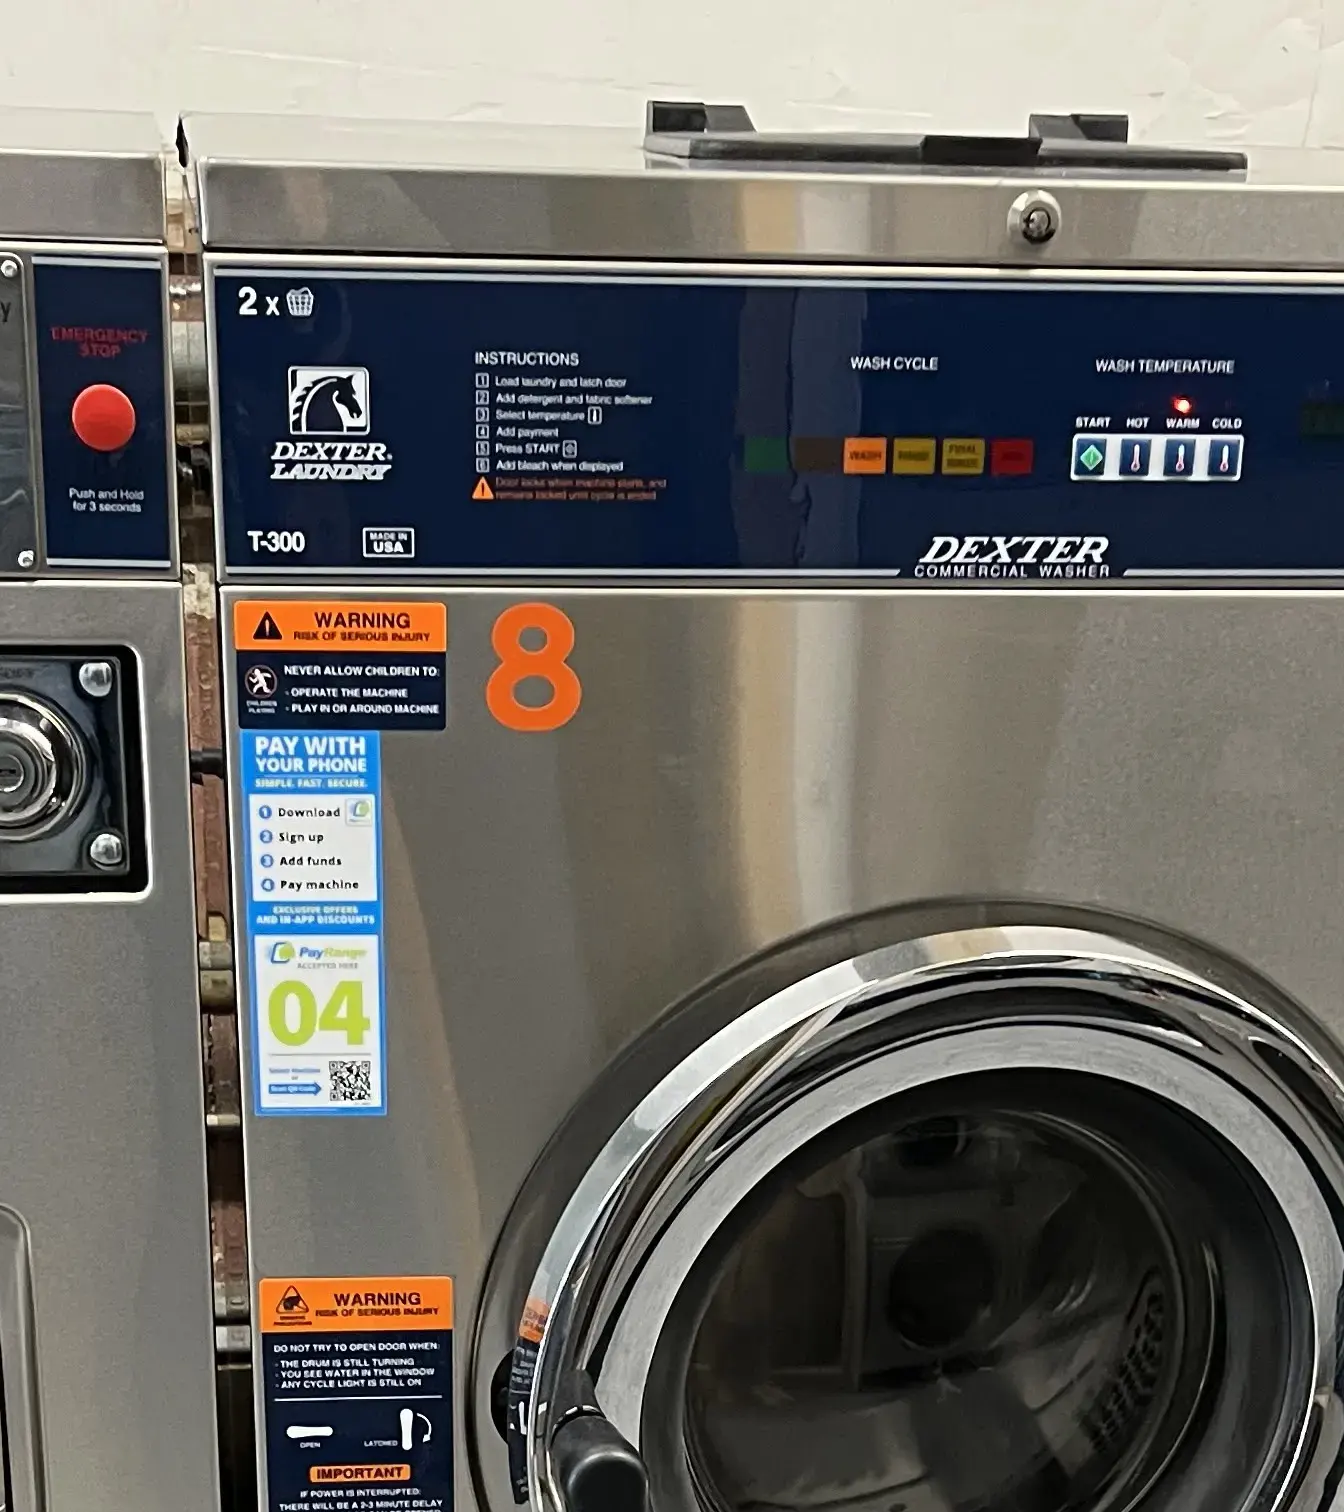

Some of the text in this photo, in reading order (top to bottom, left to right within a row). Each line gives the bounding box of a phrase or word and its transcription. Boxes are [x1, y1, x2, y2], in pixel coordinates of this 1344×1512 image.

[238, 286, 257, 315] 2
[50, 327, 148, 343] EMERGENCY
[80, 343, 121, 358] STOP
[475, 352, 579, 366] INSTRUCTIONS
[851, 357, 938, 371] WASH CYCLE
[1096, 359, 1235, 374] WASH TEMPERATURE
[1075, 417, 1242, 429] START HOT WARM COLD
[496, 427, 559, 439] Add payment
[271, 442, 387, 460] DEXTER
[496, 444, 560, 454] Press START
[270, 463, 392, 480] LAUNDRY
[69, 488, 144, 500] Push and Hold
[73, 500, 142, 512] for 3 seconds
[247, 530, 305, 552] T-300
[370, 532, 396, 540] MADE
[373, 541, 404, 553] USA
[919, 536, 1109, 563] DEXTER
[914, 564, 1110, 578] COMMERCIAL WASHER
[314, 612, 411, 629] WARNING
[293, 631, 430, 642] RISK OF SERIOUS INJURY
[284, 665, 321, 676] NEVER
[324, 665, 363, 676] ALLOW
[365, 666, 420, 677] CHILDREN
[485, 602, 582, 732] 8
[291, 688, 408, 698] OPERATE THE MACHINE
[292, 704, 439, 714] PLAY IN OR AROUND MACHINE
[256, 736, 366, 756] PAY WITH
[256, 758, 367, 773] YOUR PHONE
[278, 807, 341, 817] Download
[278, 832, 324, 844] Sign up
[280, 856, 342, 866] Add funds
[280, 880, 359, 892] Pay machine
[299, 946, 369, 961] PayRange
[268, 979, 371, 1047] 04
[334, 1292, 421, 1307] WARNING
[315, 1308, 439, 1317] RISK OF SERIOUS INJURY
[274, 1344, 288, 1353] DO
[289, 1344, 310, 1353] NOT
[313, 1344, 331, 1352] TRY
[334, 1344, 347, 1352] TO
[349, 1343, 376, 1351] OPEN
[378, 1343, 406, 1351] DOOR
[317, 1467, 403, 1479] IMPORTANT
